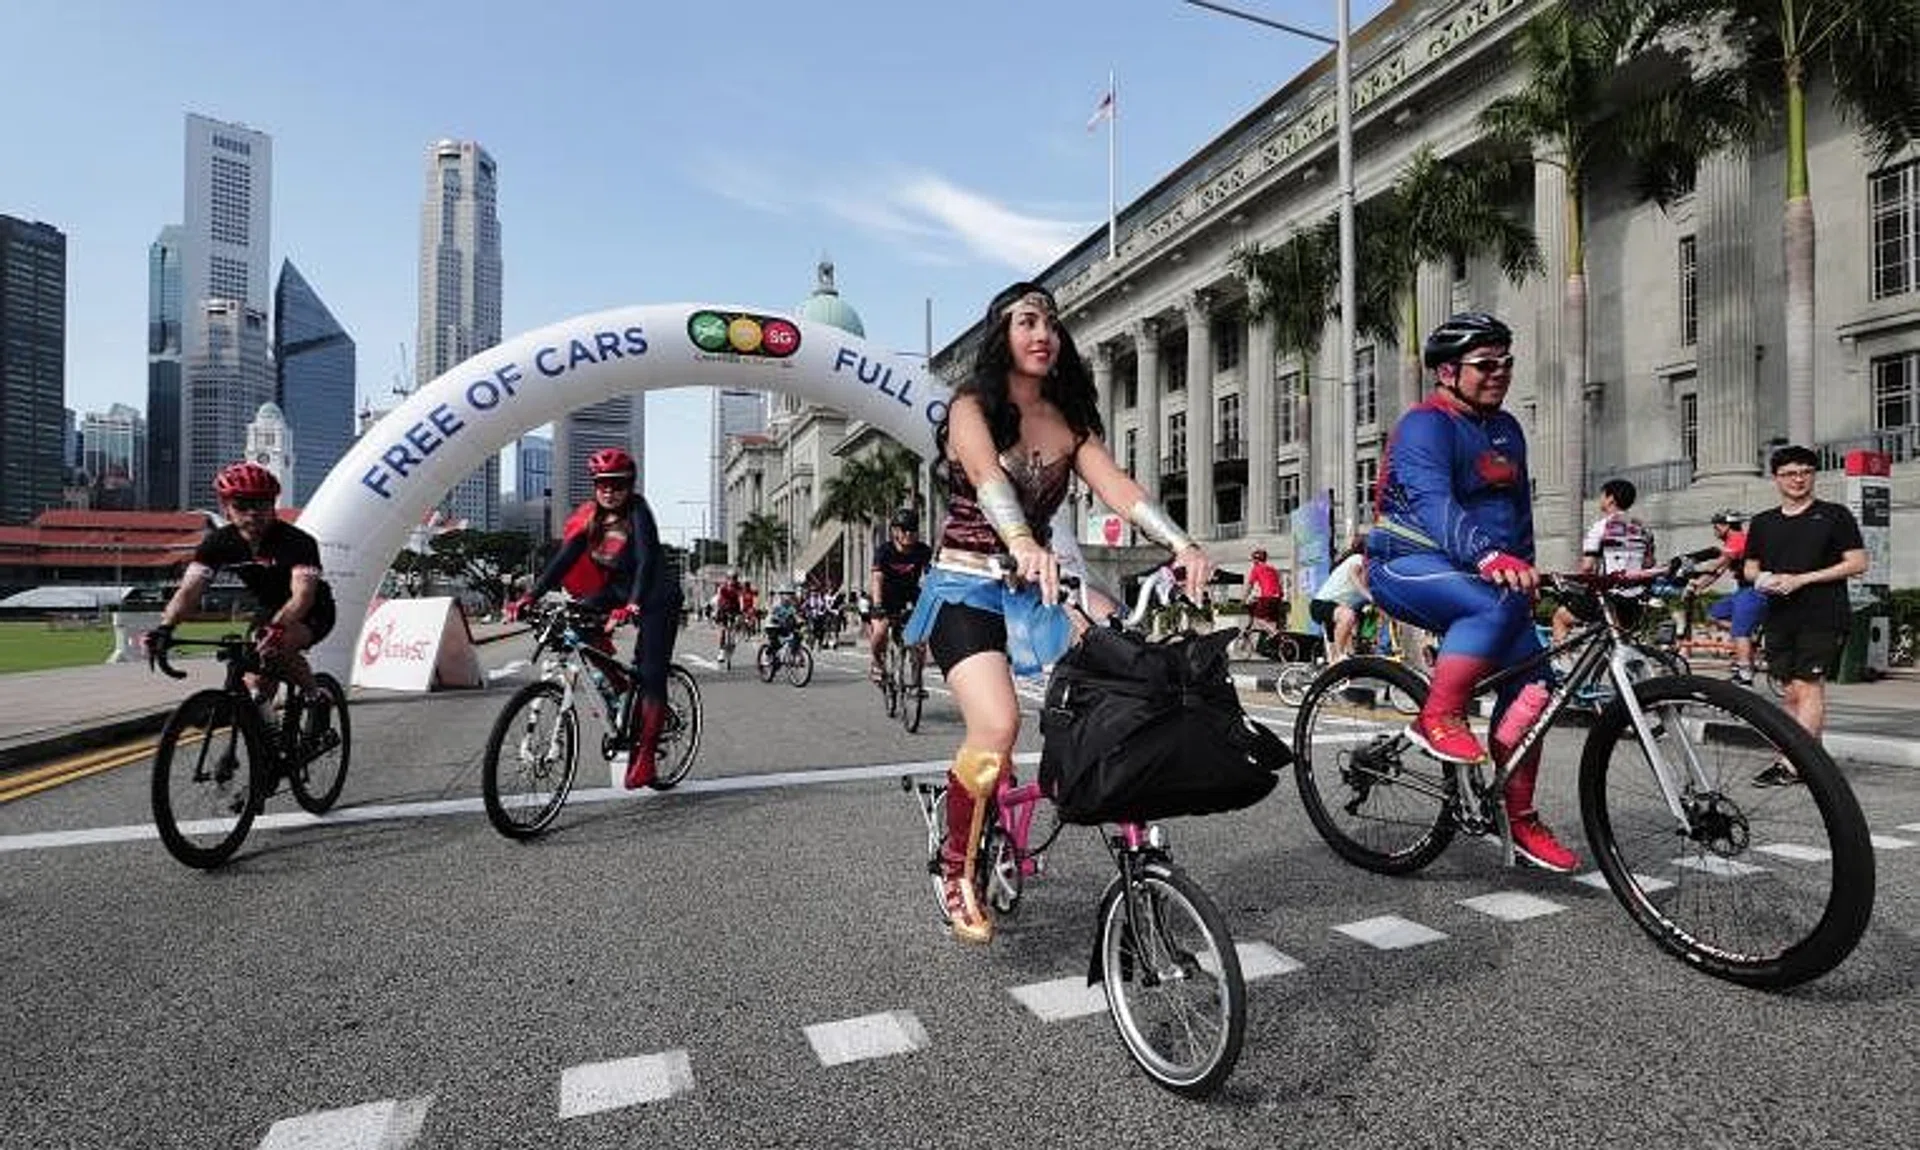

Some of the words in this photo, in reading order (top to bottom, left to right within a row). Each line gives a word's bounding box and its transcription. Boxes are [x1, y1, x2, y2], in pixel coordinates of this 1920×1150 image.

[769, 330, 791, 343] SG
[362, 404, 464, 499] FREE
[466, 363, 522, 410] OF
[536, 327, 648, 377] CARS
[835, 347, 912, 406] FULL
[926, 400, 949, 425] O
